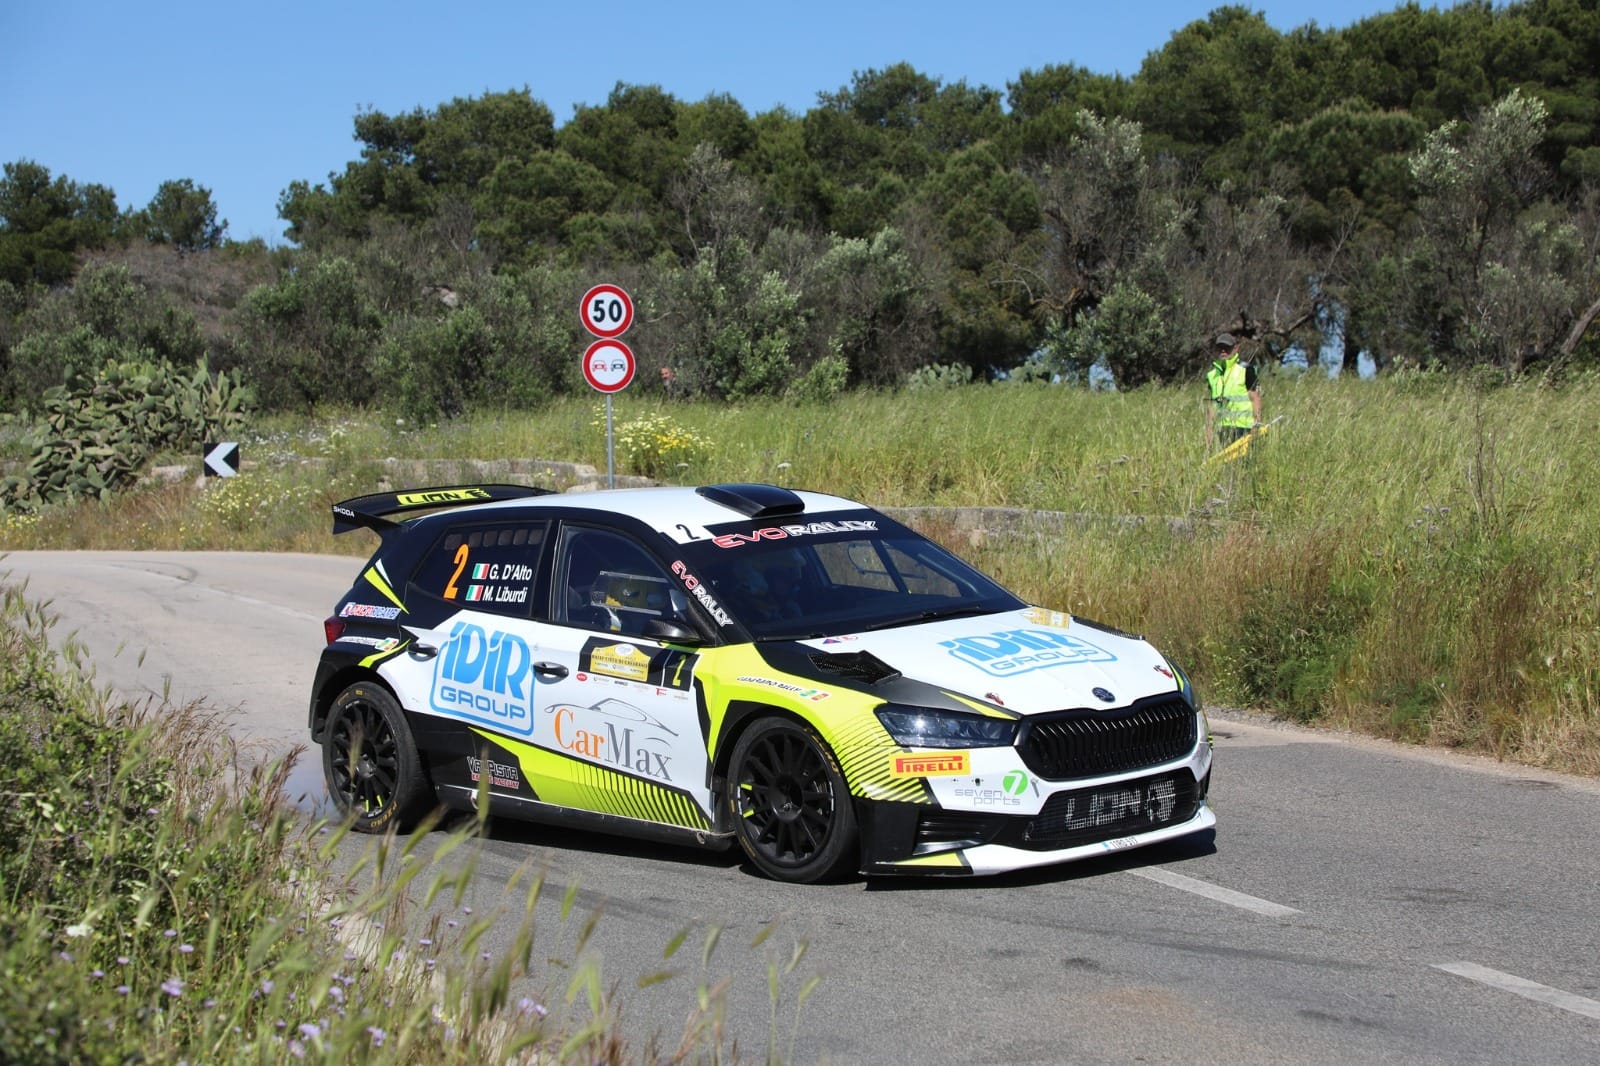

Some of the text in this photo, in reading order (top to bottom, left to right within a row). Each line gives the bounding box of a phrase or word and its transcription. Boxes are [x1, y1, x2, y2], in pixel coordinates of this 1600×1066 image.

[593, 300, 622, 322] 50
[405, 493, 459, 504] LION
[676, 524, 700, 540] 2
[443, 543, 469, 599] 2
[489, 564, 533, 580] G. D'Alto
[482, 585, 528, 602] M. Liburdi
[989, 649, 1099, 670] GROUP
[672, 655, 686, 687] 2
[440, 686, 526, 718] GROUP
[554, 708, 673, 782] CarMax
[896, 756, 963, 773] PIRELLI
[954, 789, 1002, 798] seven
[973, 796, 1021, 806] ports
